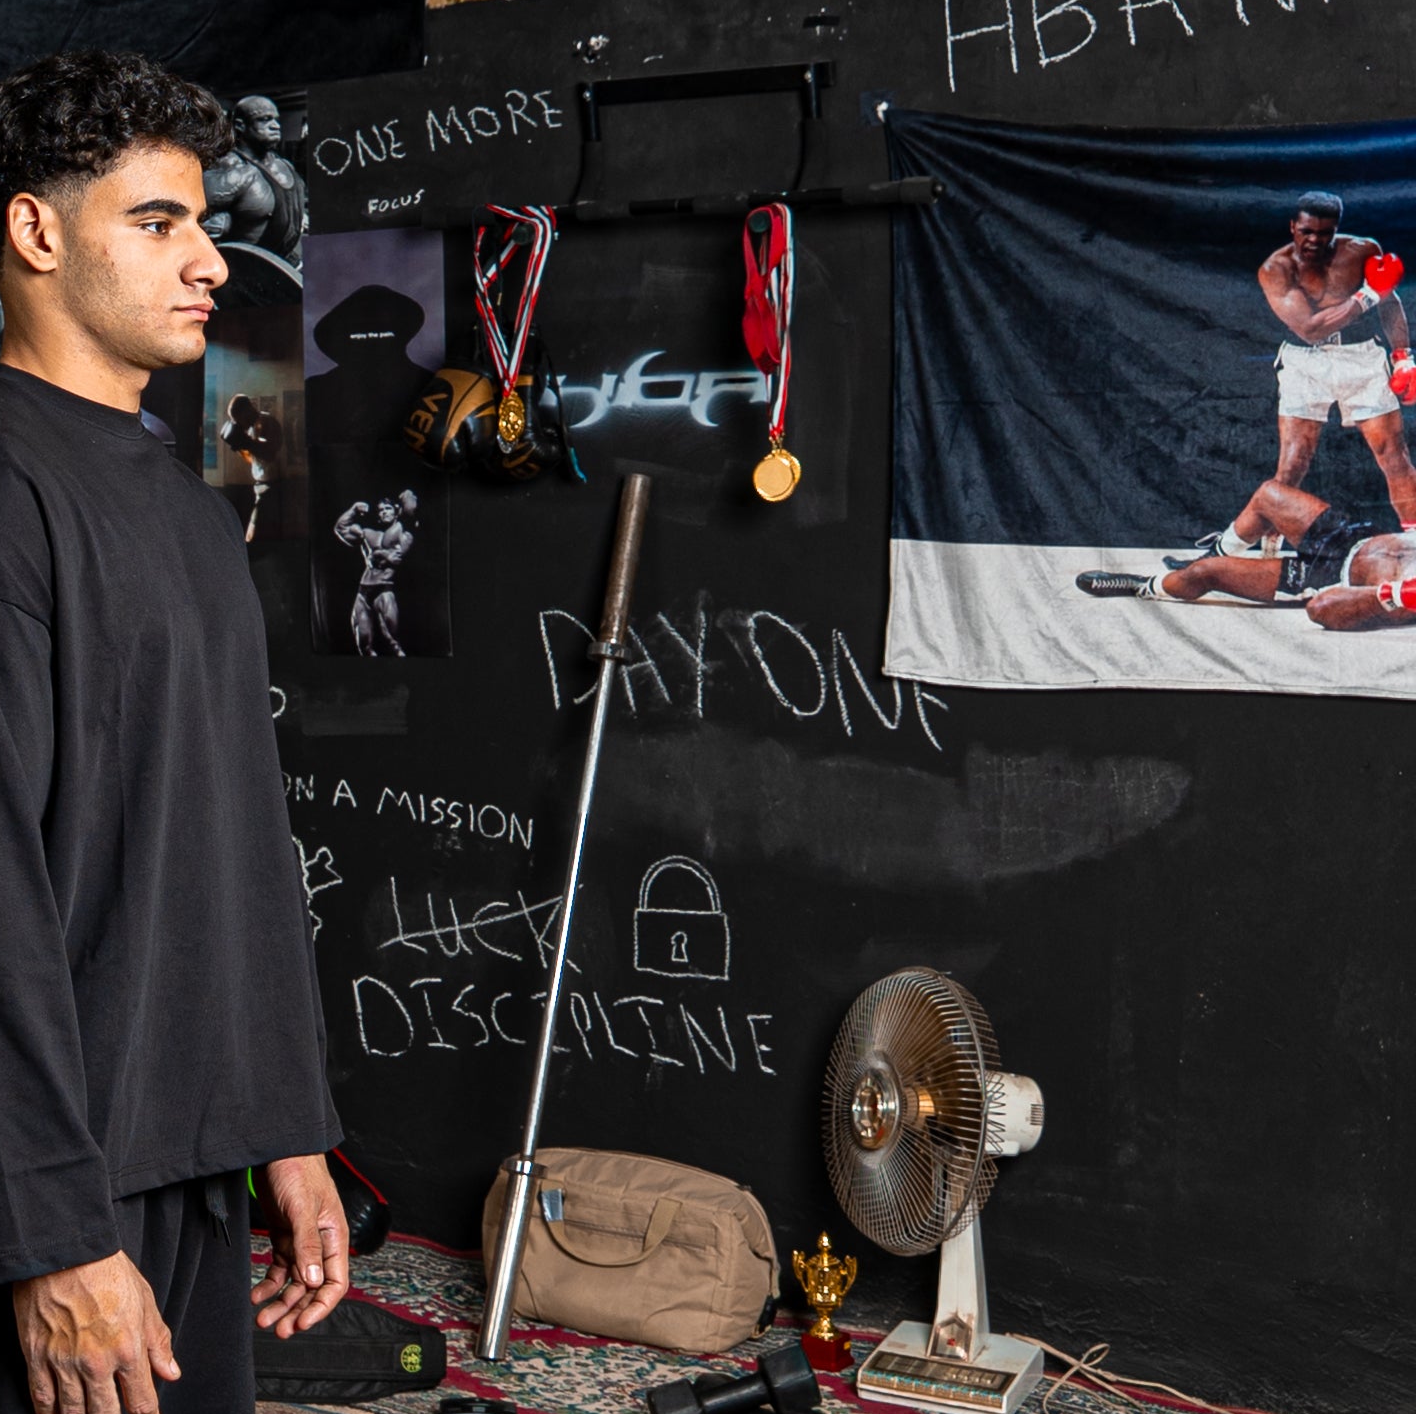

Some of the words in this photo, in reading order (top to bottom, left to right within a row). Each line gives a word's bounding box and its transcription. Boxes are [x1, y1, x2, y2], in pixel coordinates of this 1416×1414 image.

[314, 119, 406, 176] ONE
[425, 90, 563, 152] MORE
[367, 188, 425, 215] FOCUS
[540, 605, 707, 719] DAY
[333, 778, 357, 808] A
[377, 786, 534, 850] MISSION
[381, 876, 583, 974] LUCK
